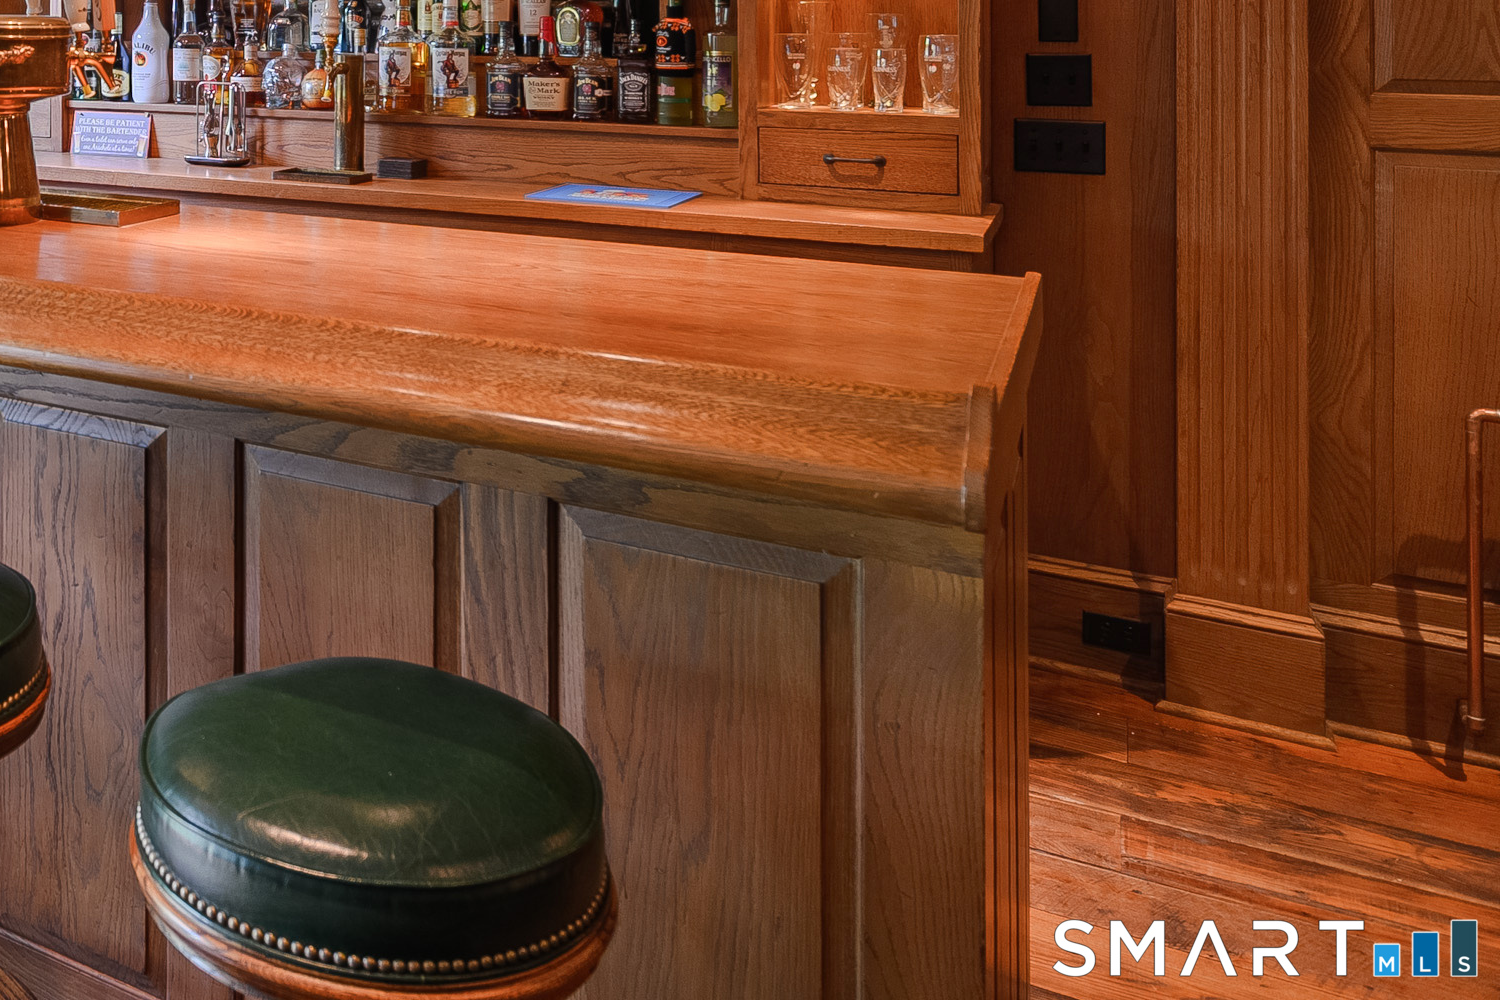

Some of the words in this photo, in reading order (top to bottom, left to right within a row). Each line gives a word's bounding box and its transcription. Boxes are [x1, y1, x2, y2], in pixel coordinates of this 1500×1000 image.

[78, 117, 105, 126] PLEASE
[115, 119, 146, 128] PATIENT
[75, 125, 91, 133] WITH
[92, 126, 106, 134] THE
[106, 127, 148, 136] BARTENDER
